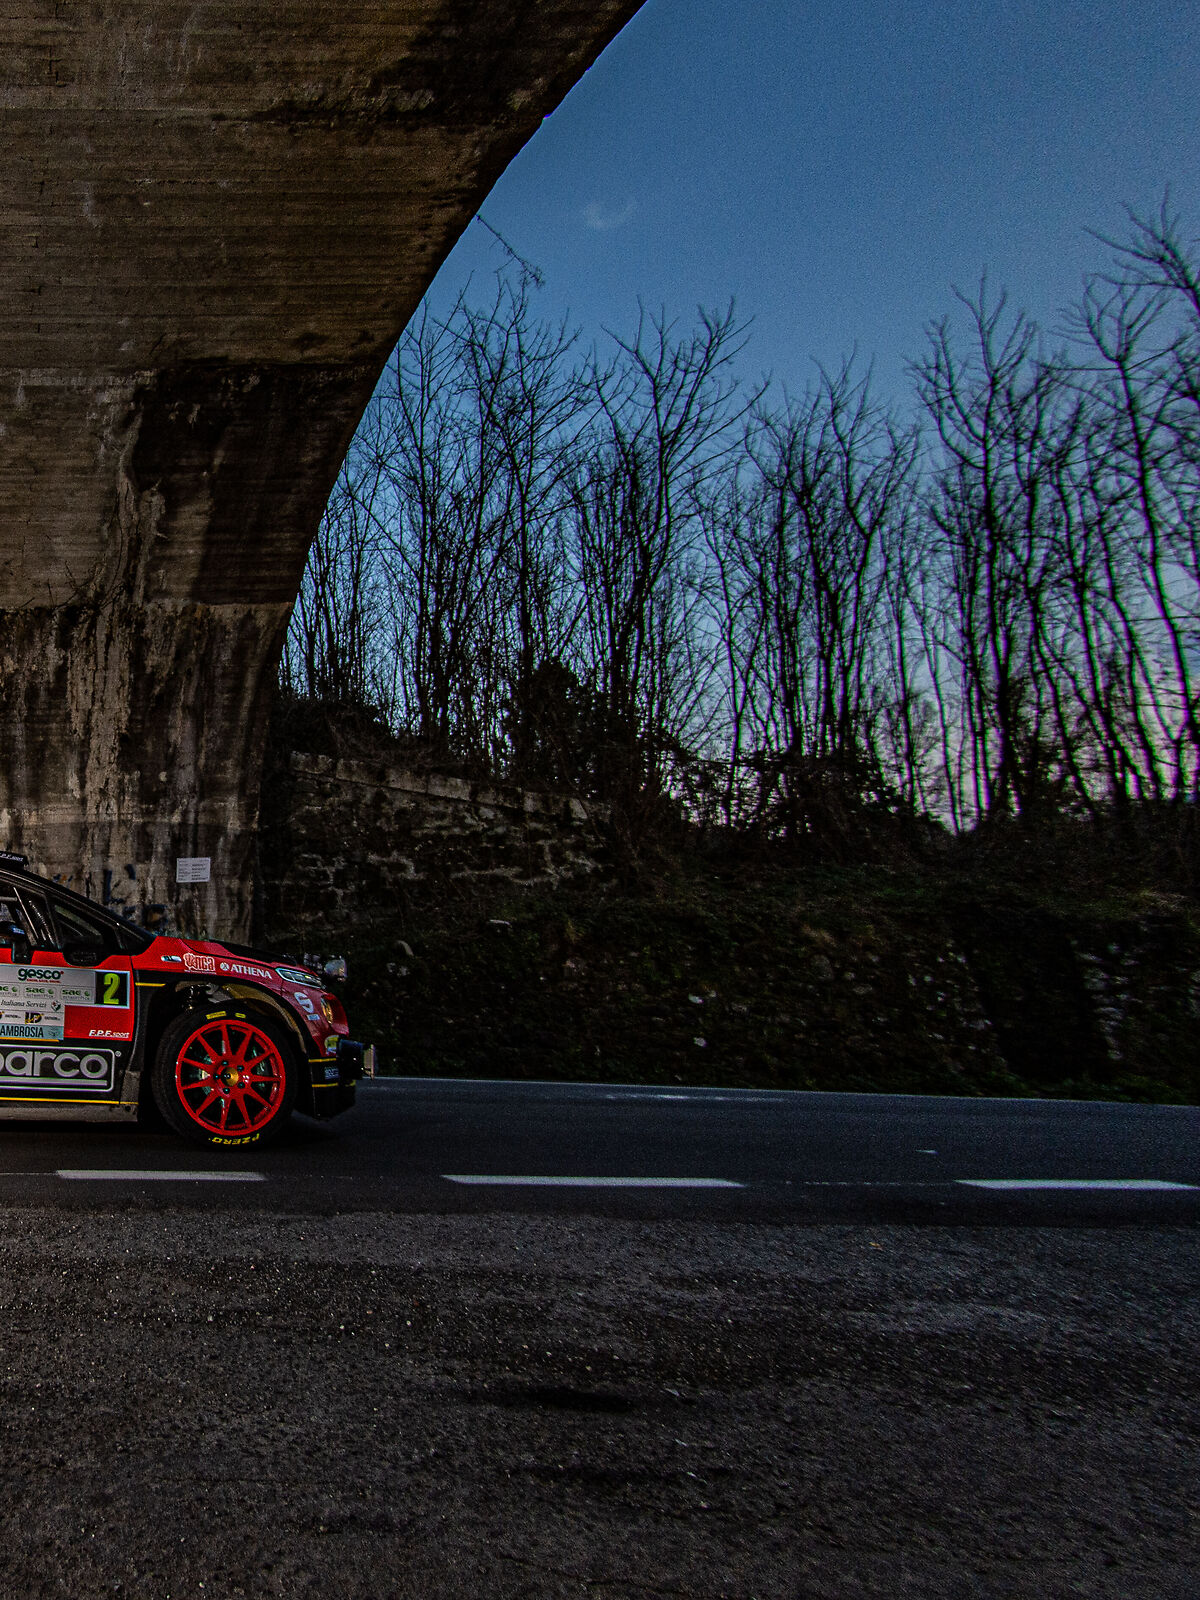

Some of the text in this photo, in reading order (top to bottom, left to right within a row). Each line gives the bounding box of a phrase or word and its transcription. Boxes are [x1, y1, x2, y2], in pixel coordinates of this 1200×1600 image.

[18, 968, 61, 981] gesco
[231, 963, 273, 979] ATHENA
[103, 973, 120, 1005] 2
[0, 999, 25, 1008] Italiana
[0, 1025, 44, 1038] AMBROSIA
